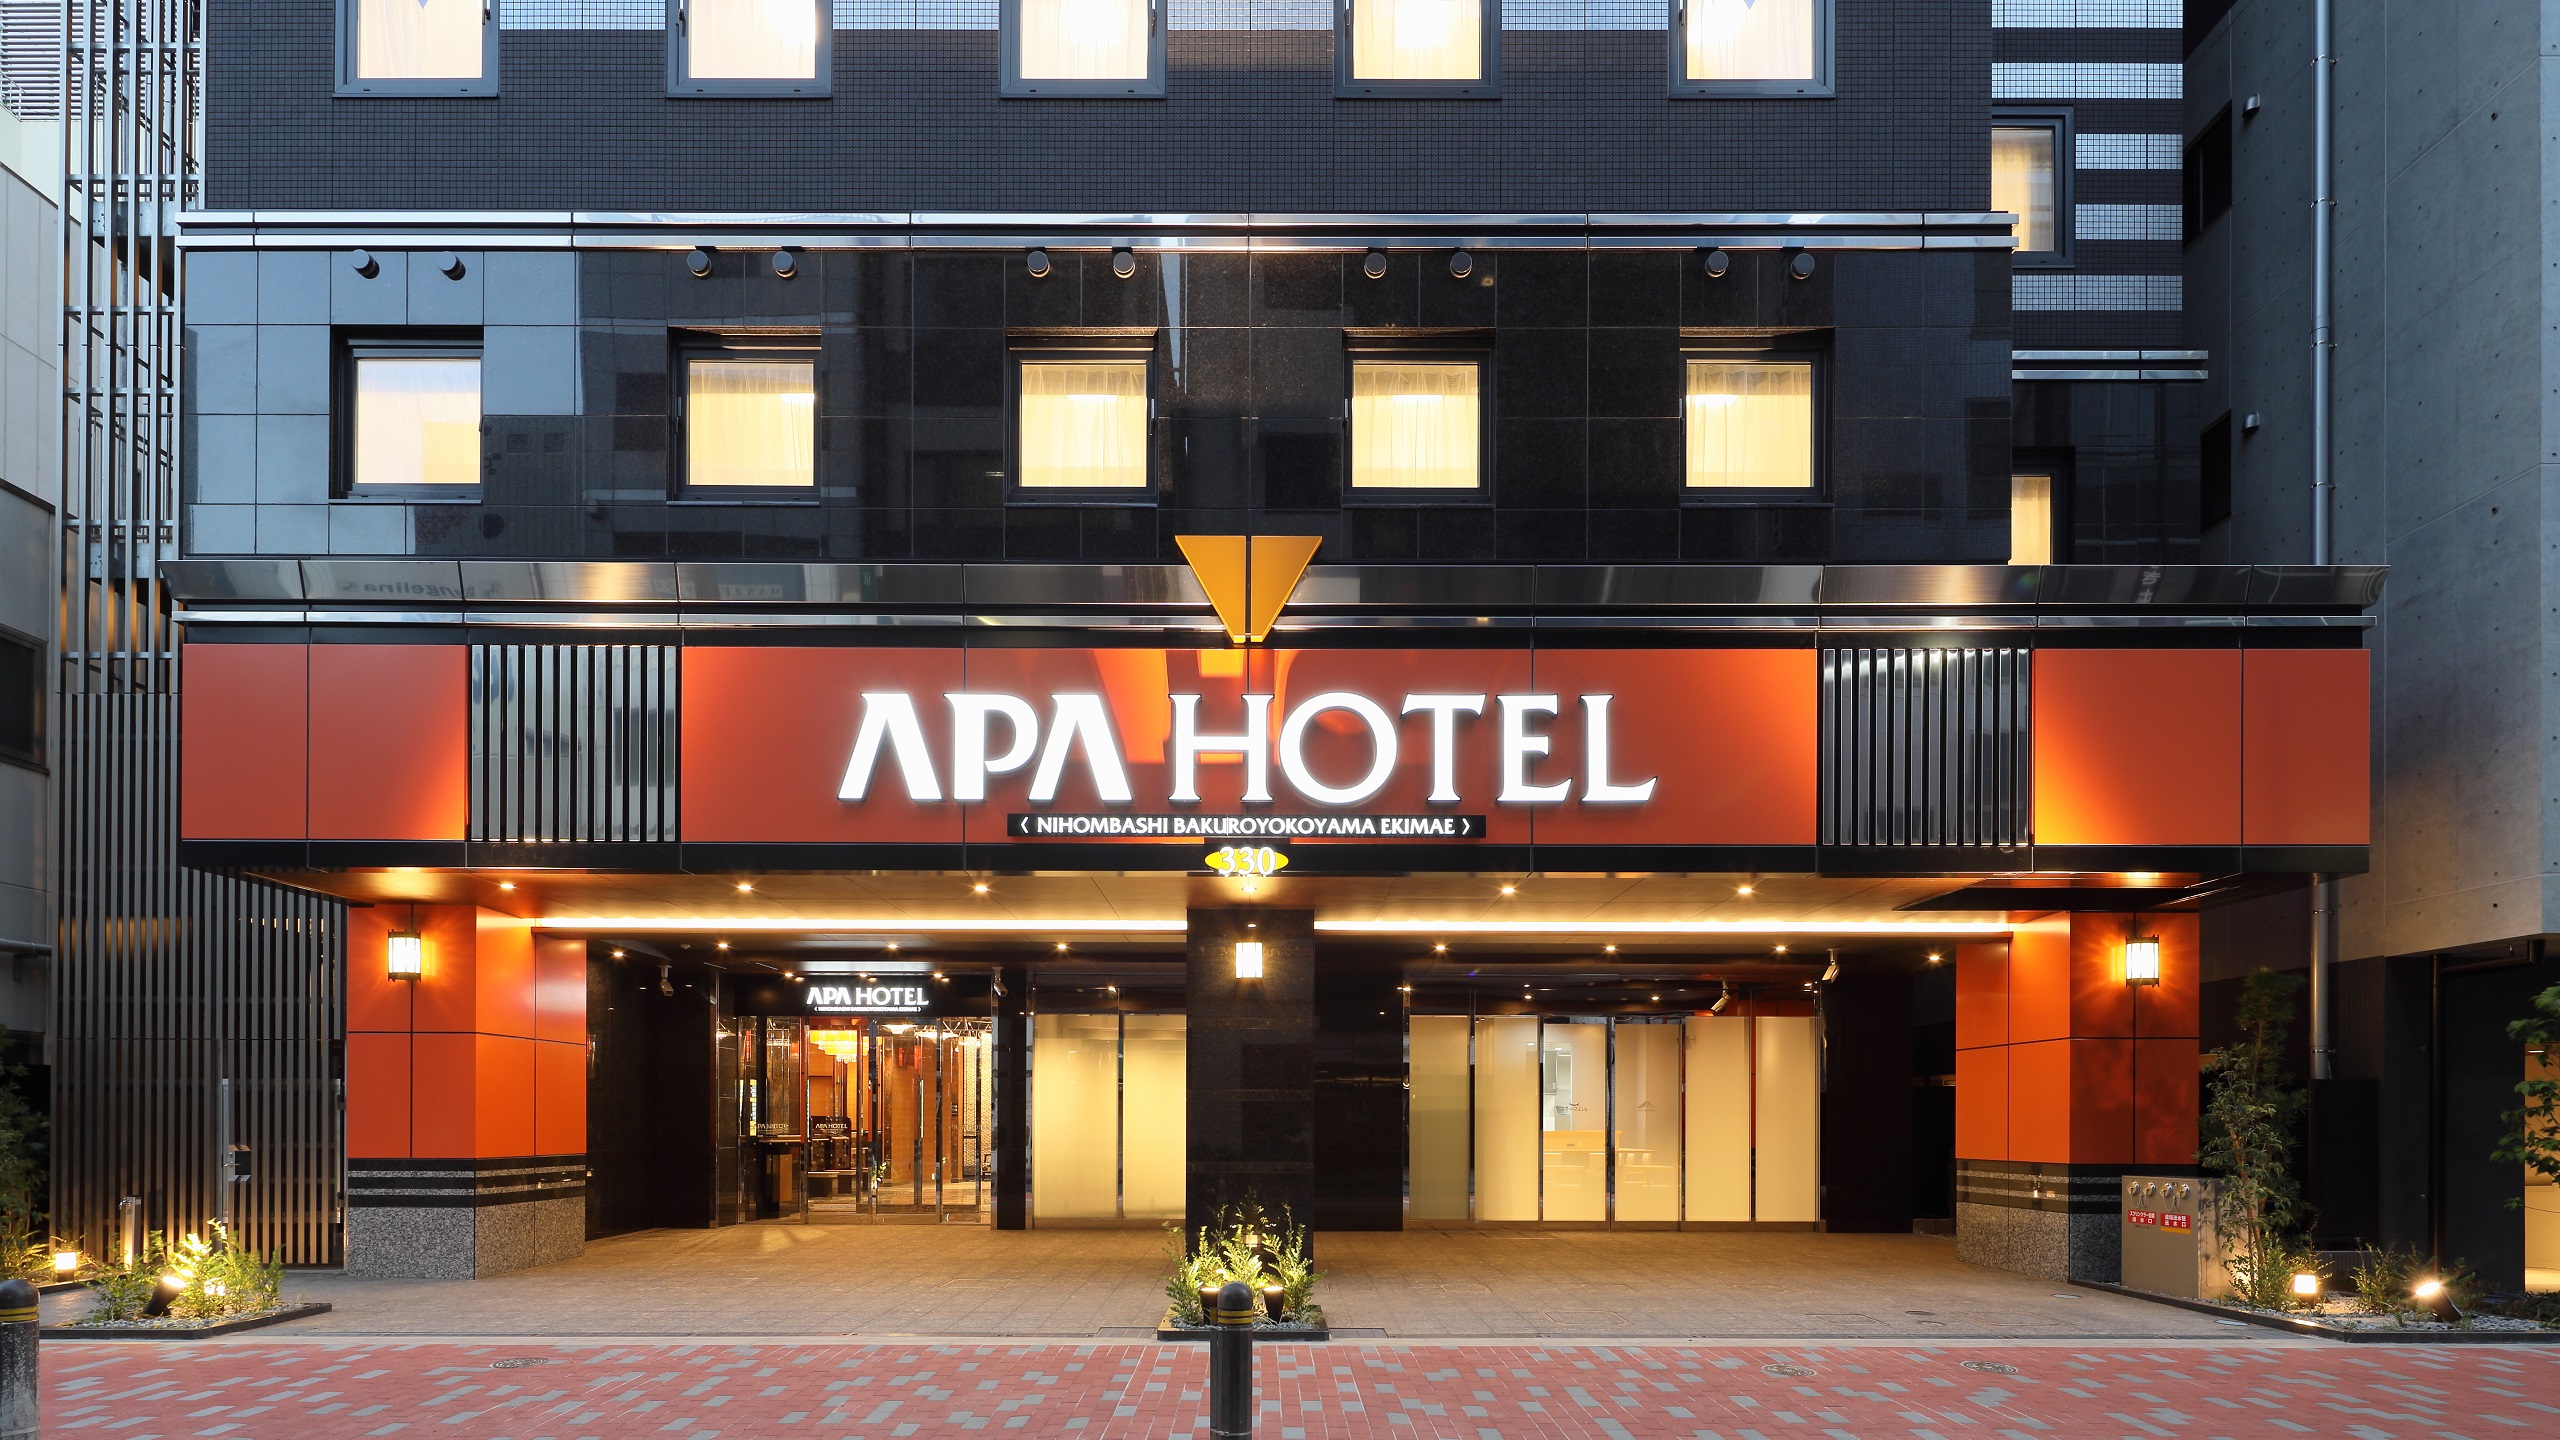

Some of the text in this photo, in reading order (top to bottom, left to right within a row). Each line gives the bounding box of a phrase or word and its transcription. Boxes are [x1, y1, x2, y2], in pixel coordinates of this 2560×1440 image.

[838, 691, 1657, 803] APA HOTEL
[1037, 817, 1455, 835] NIHOMBASHI BAKUROYOKOYAMA EKIMAE
[1218, 846, 1276, 876] 330
[806, 987, 930, 1005] APA HOTEL
